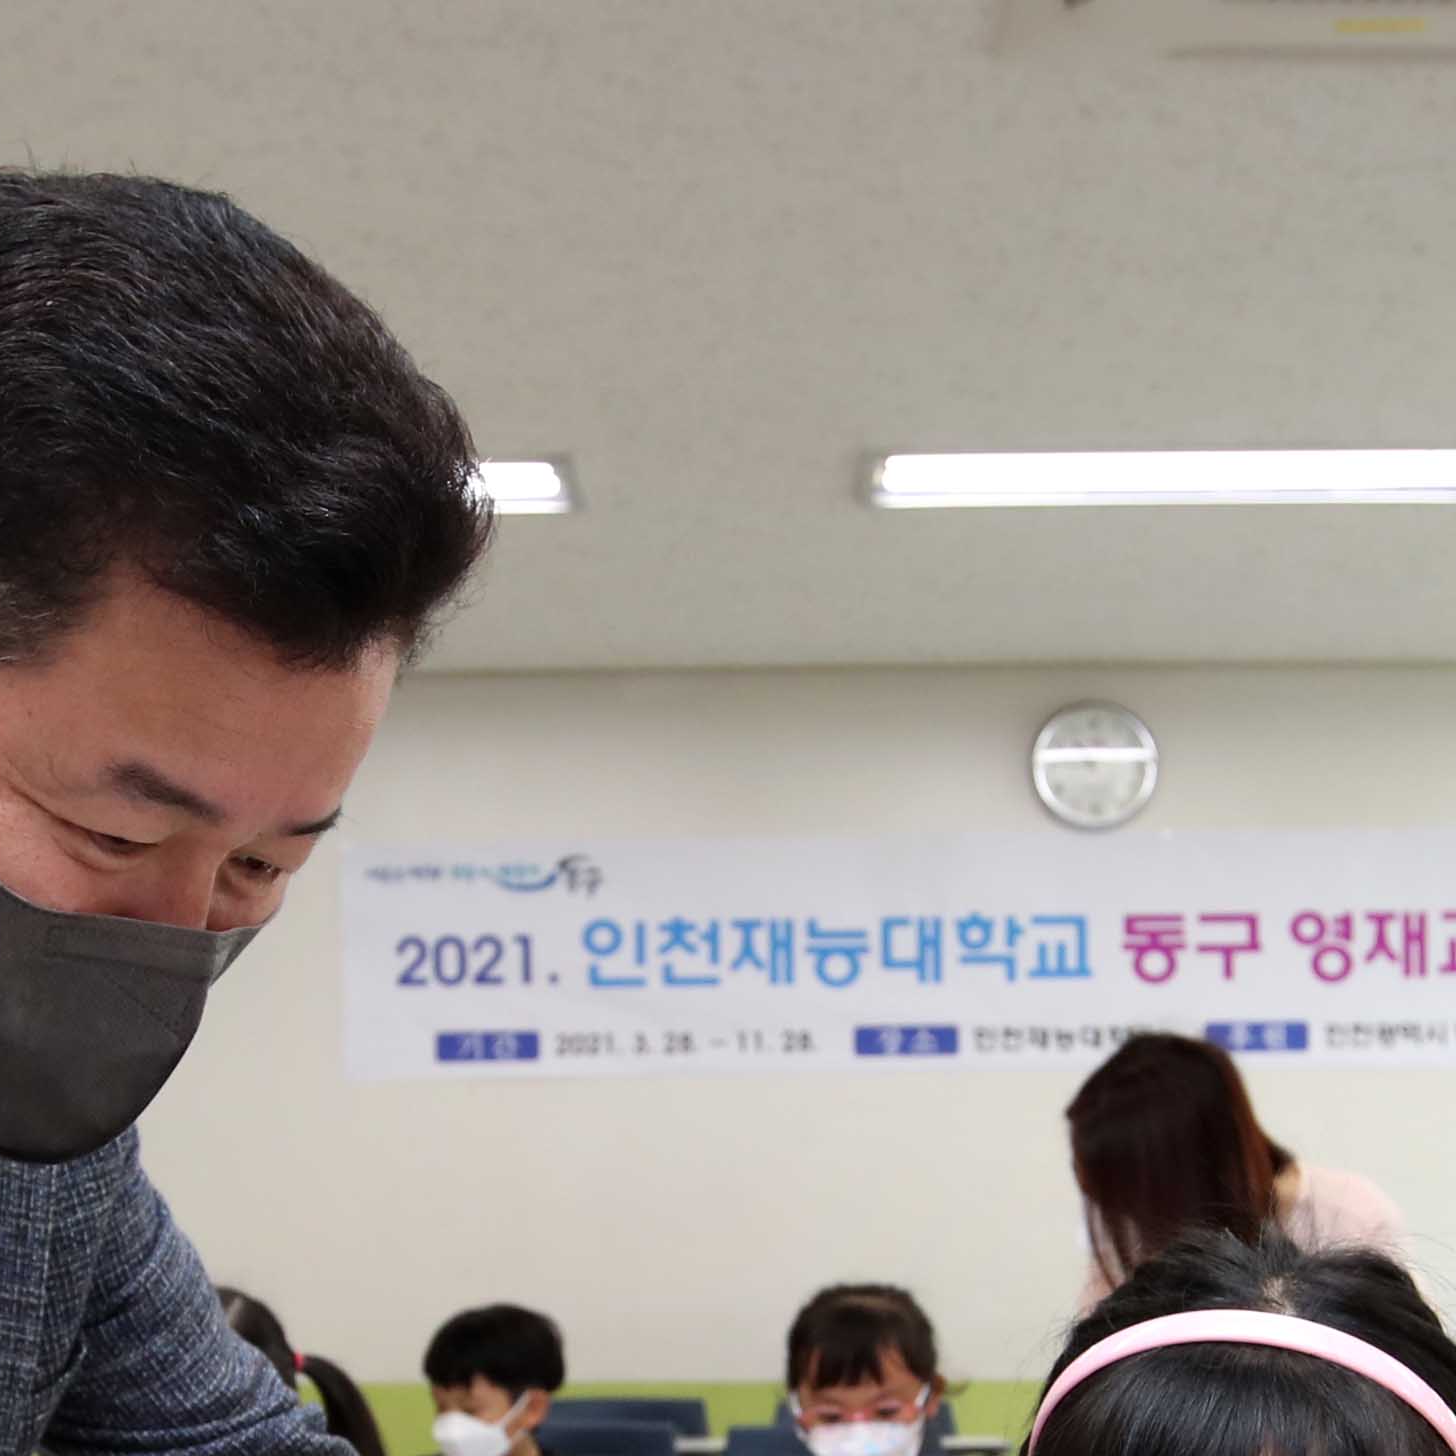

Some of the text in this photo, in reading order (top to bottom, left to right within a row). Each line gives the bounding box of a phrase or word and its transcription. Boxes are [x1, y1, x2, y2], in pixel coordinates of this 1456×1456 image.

[396, 934, 560, 989] 2021.
[583, 910, 1093, 988] 인천재능대학교
[1122, 914, 1262, 983] 동구
